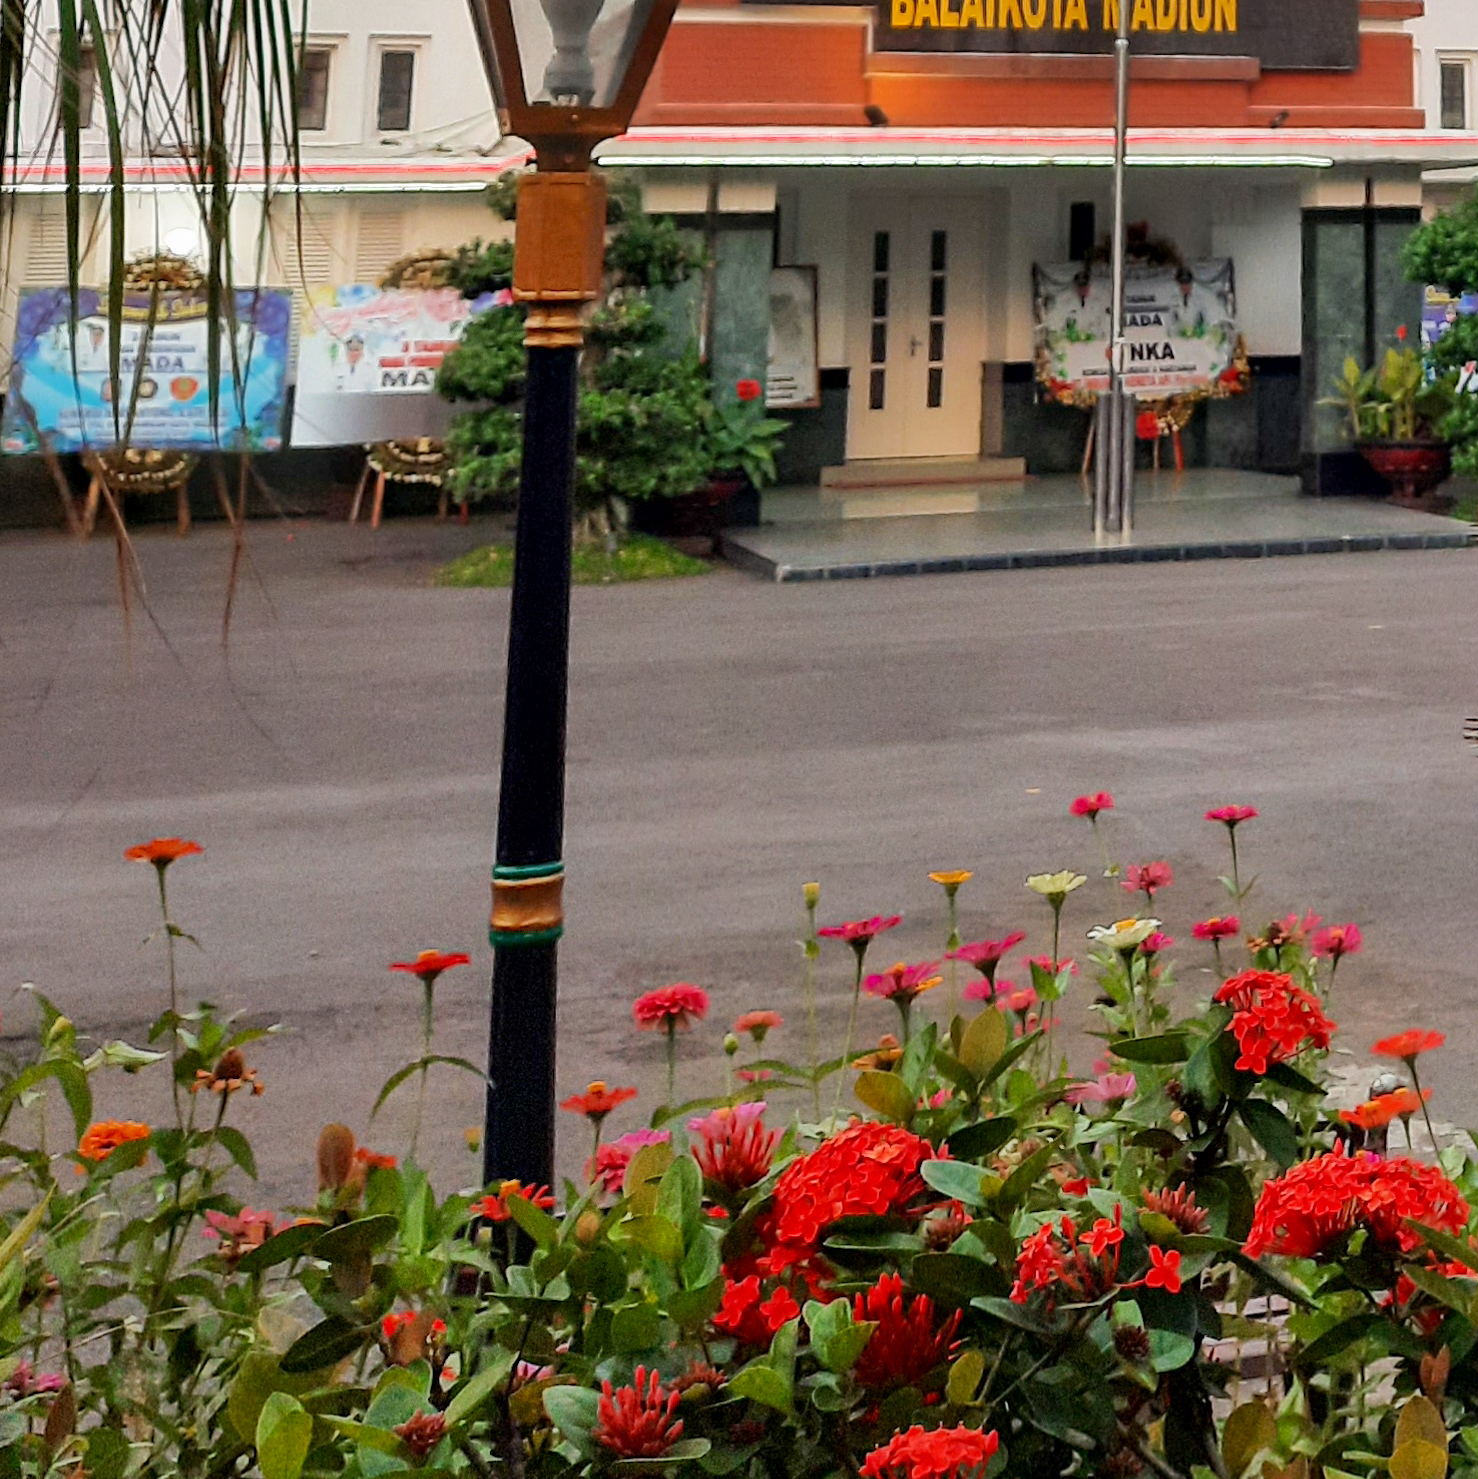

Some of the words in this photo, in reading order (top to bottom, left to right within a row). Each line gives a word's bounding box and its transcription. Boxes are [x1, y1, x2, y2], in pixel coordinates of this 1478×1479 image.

[1125, 312, 1164, 327] ADA
[1130, 342, 1175, 361] NKA
[382, 371, 430, 387] MA
